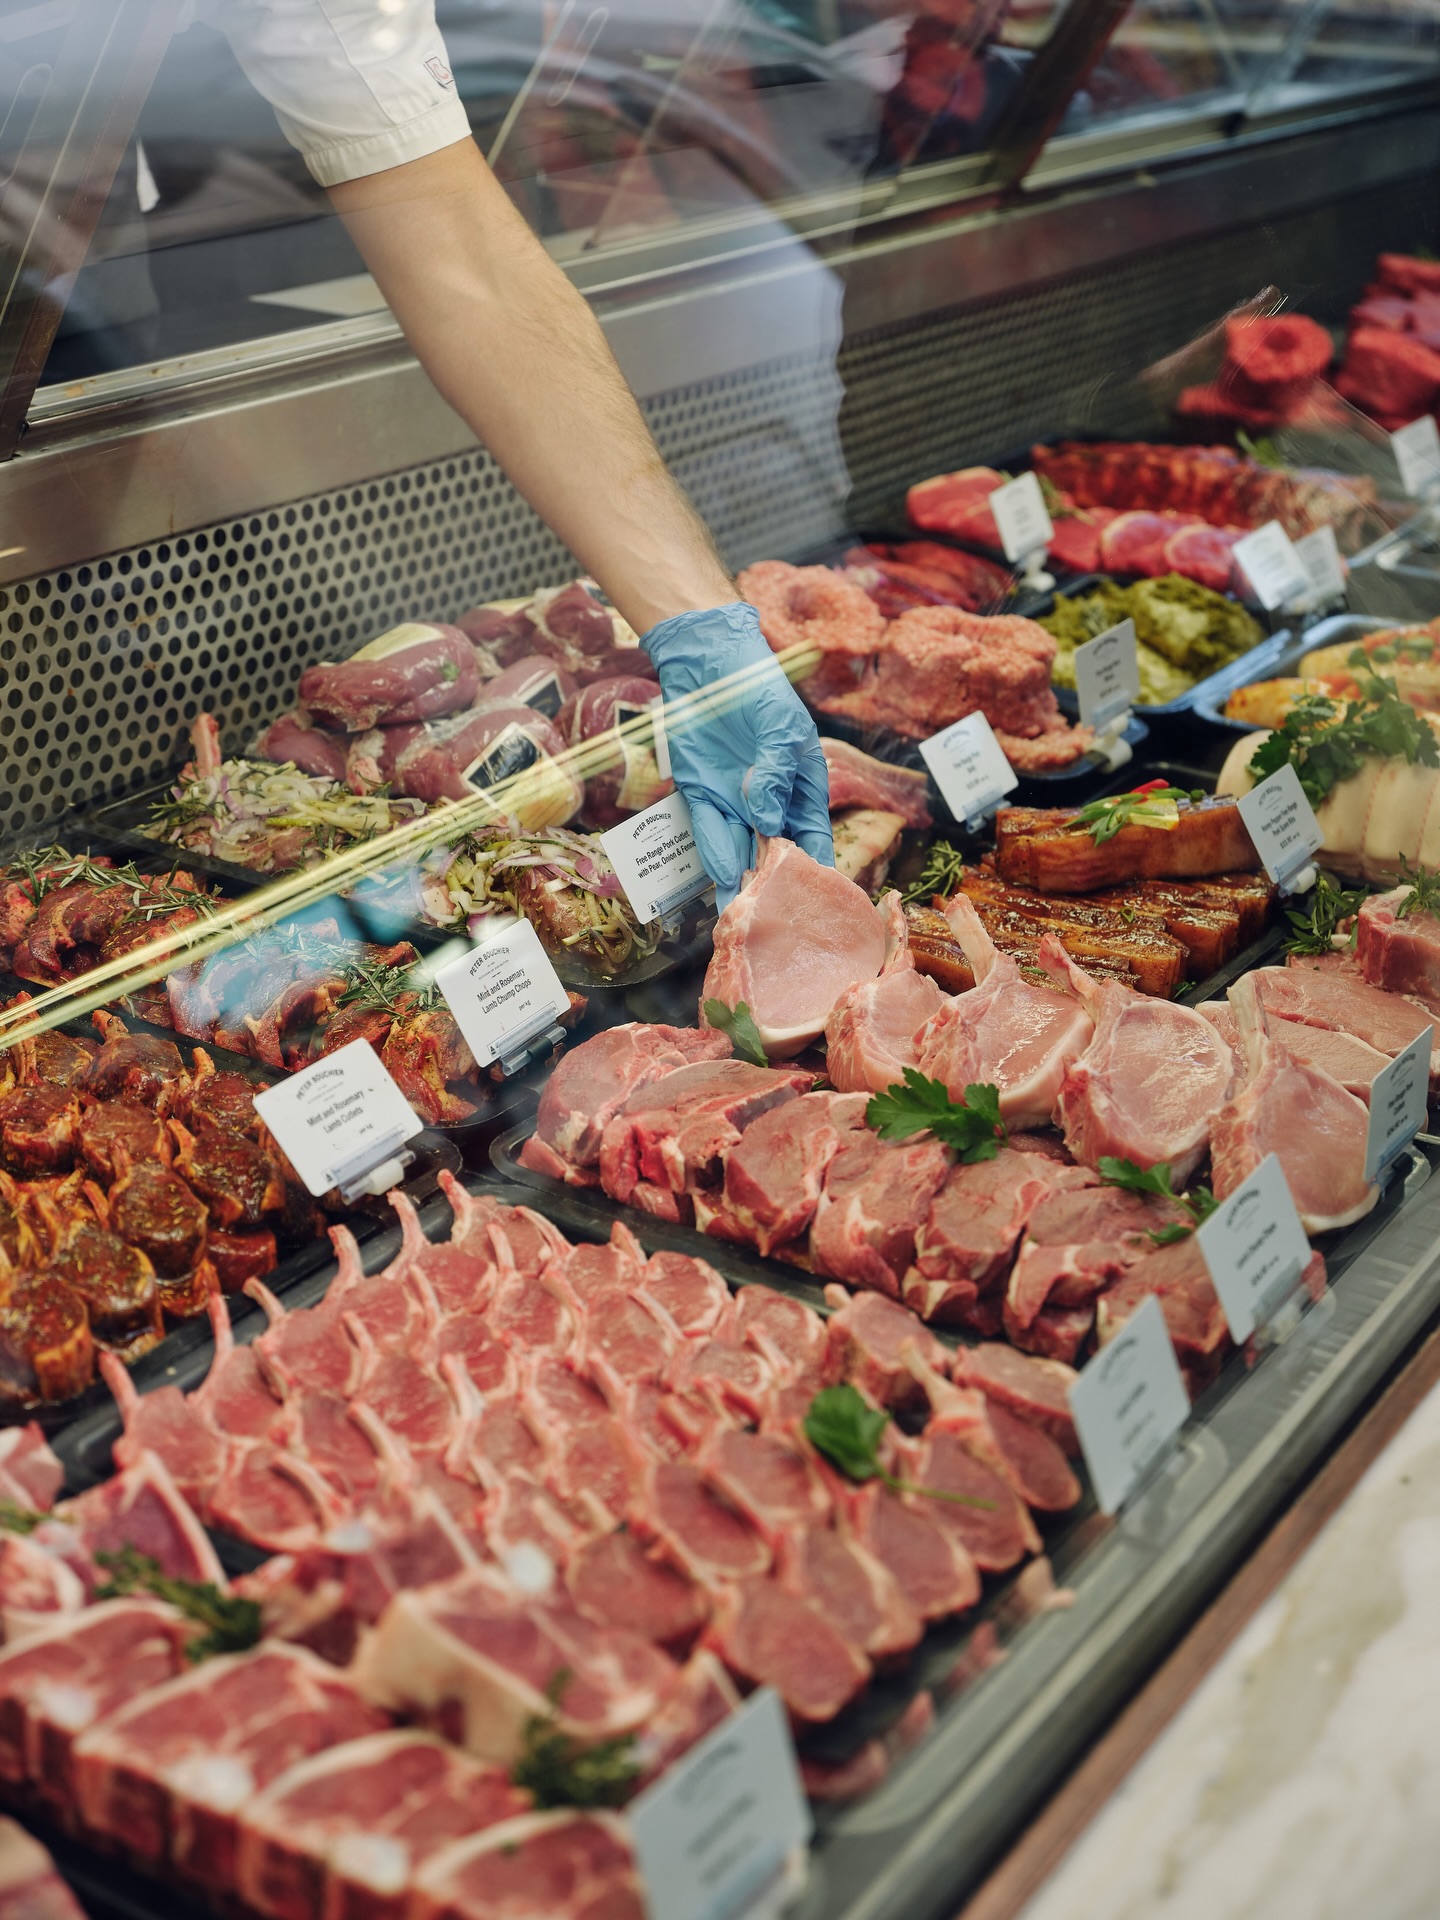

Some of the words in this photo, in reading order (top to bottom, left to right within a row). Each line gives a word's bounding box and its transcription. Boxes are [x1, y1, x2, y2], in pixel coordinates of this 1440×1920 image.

[633, 821, 646, 840] PETER
[646, 813, 672, 825] BOUCHIER
[635, 854, 648, 866] Free
[647, 846, 663, 860] Range
[662, 837, 676, 850] Pork
[673, 830, 690, 844] Cutlet
[638, 867, 650, 878] with
[649, 861, 663, 873] Pear,
[661, 851, 677, 865] Onion
[676, 848, 682, 856] &
[680, 840, 697, 853] Fenne
[469, 957, 483, 976] PETER
[483, 947, 509, 960] BOUCHIER
[477, 990, 490, 1002] Mint
[490, 983, 501, 995] and
[500, 968, 525, 988] Rosemary
[482, 999, 498, 1014] Lamb
[496, 988, 516, 1005] Chump
[514, 978, 532, 993] Chops
[296, 1081, 312, 1100] PETER
[312, 1069, 344, 1083] BOUCHIER
[306, 1114, 322, 1127] Mint
[323, 1107, 335, 1119] and
[334, 1090, 364, 1111] Rosemary
[323, 1119, 341, 1134] Lamb
[340, 1106, 363, 1124] Cutlets
